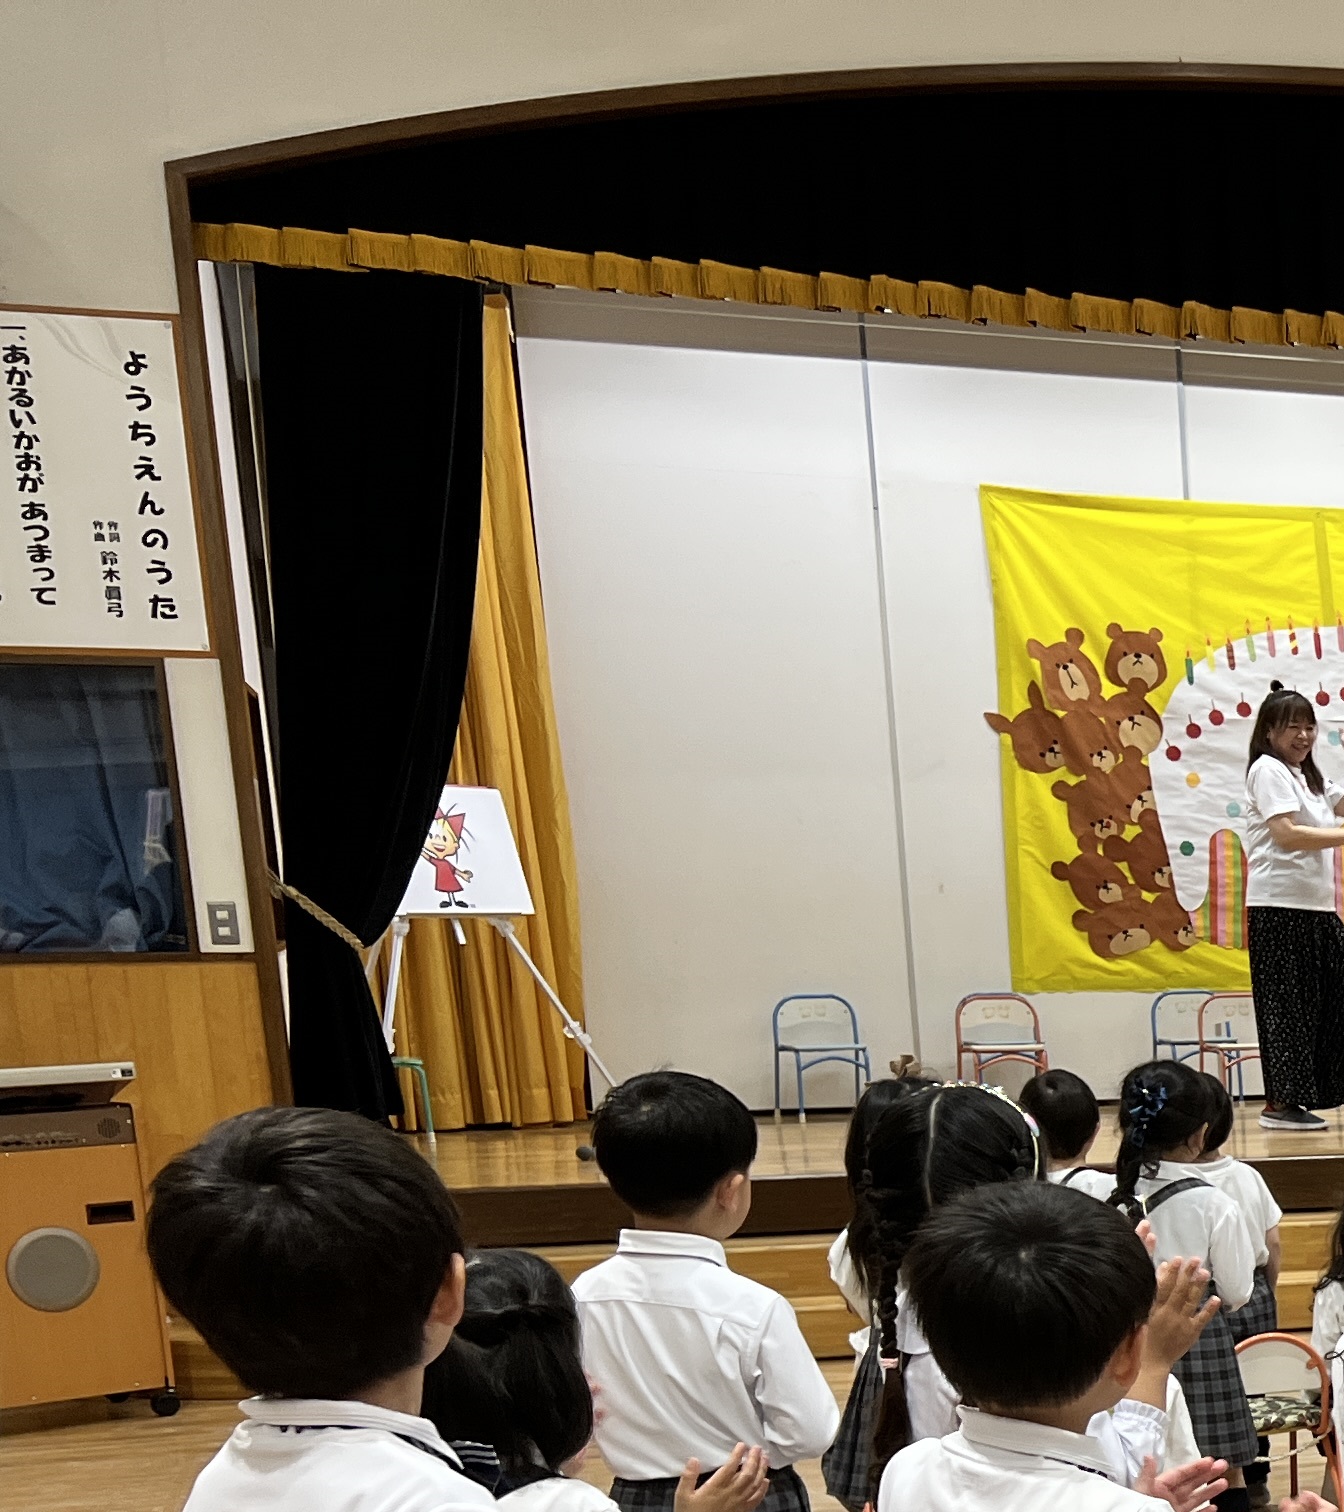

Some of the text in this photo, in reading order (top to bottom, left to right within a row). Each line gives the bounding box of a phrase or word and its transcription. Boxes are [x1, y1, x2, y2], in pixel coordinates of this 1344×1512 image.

[21, 501, 57, 605] あつまって
[123, 350, 178, 619] ようちえんのうた
